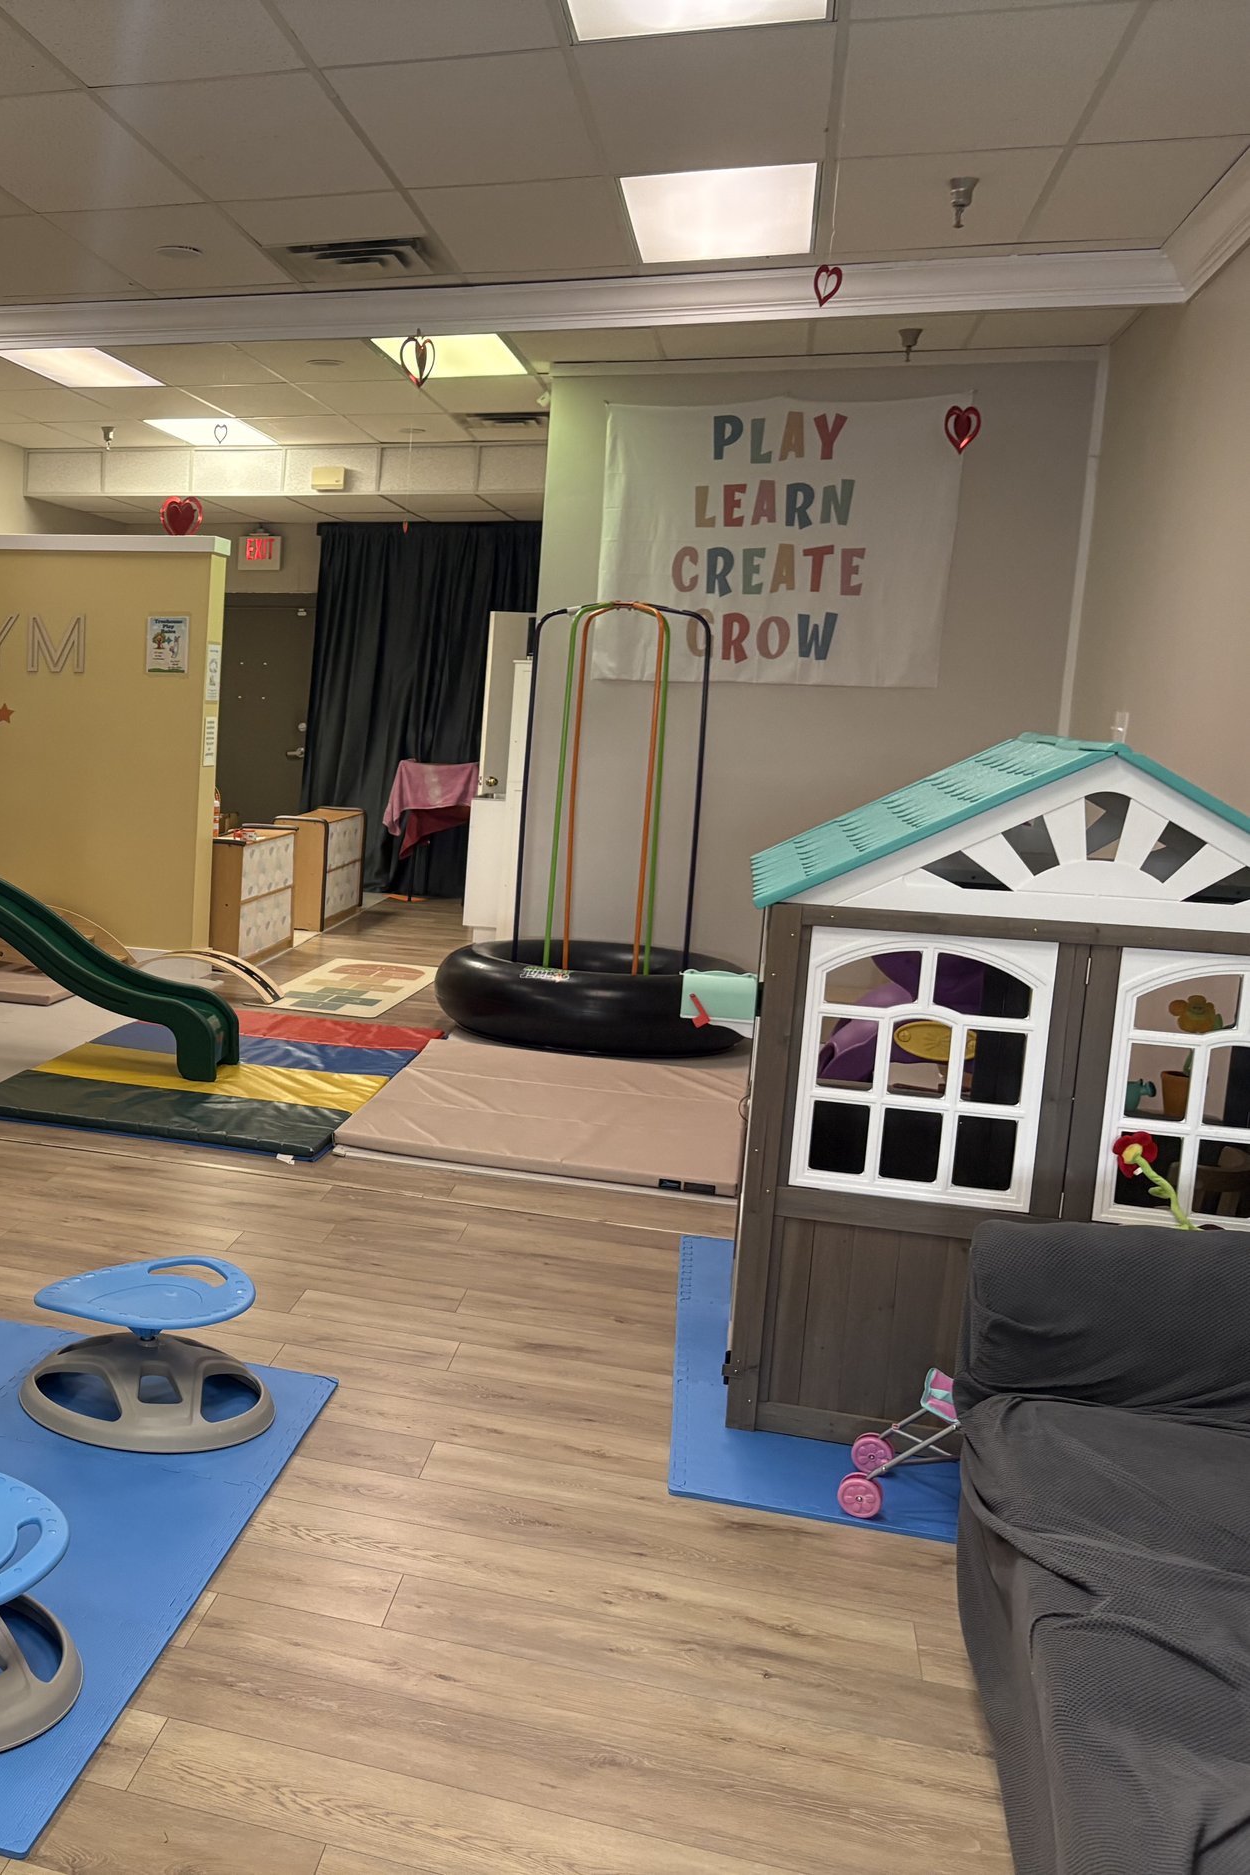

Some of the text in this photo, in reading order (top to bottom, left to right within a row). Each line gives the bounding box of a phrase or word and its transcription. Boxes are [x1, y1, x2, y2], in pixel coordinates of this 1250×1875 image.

[712, 410, 848, 464] PLAY
[694, 478, 855, 530] LEARN
[246, 538, 275, 560] EXIT
[671, 543, 866, 597] CREATE
[685, 608, 838, 664] GROW
